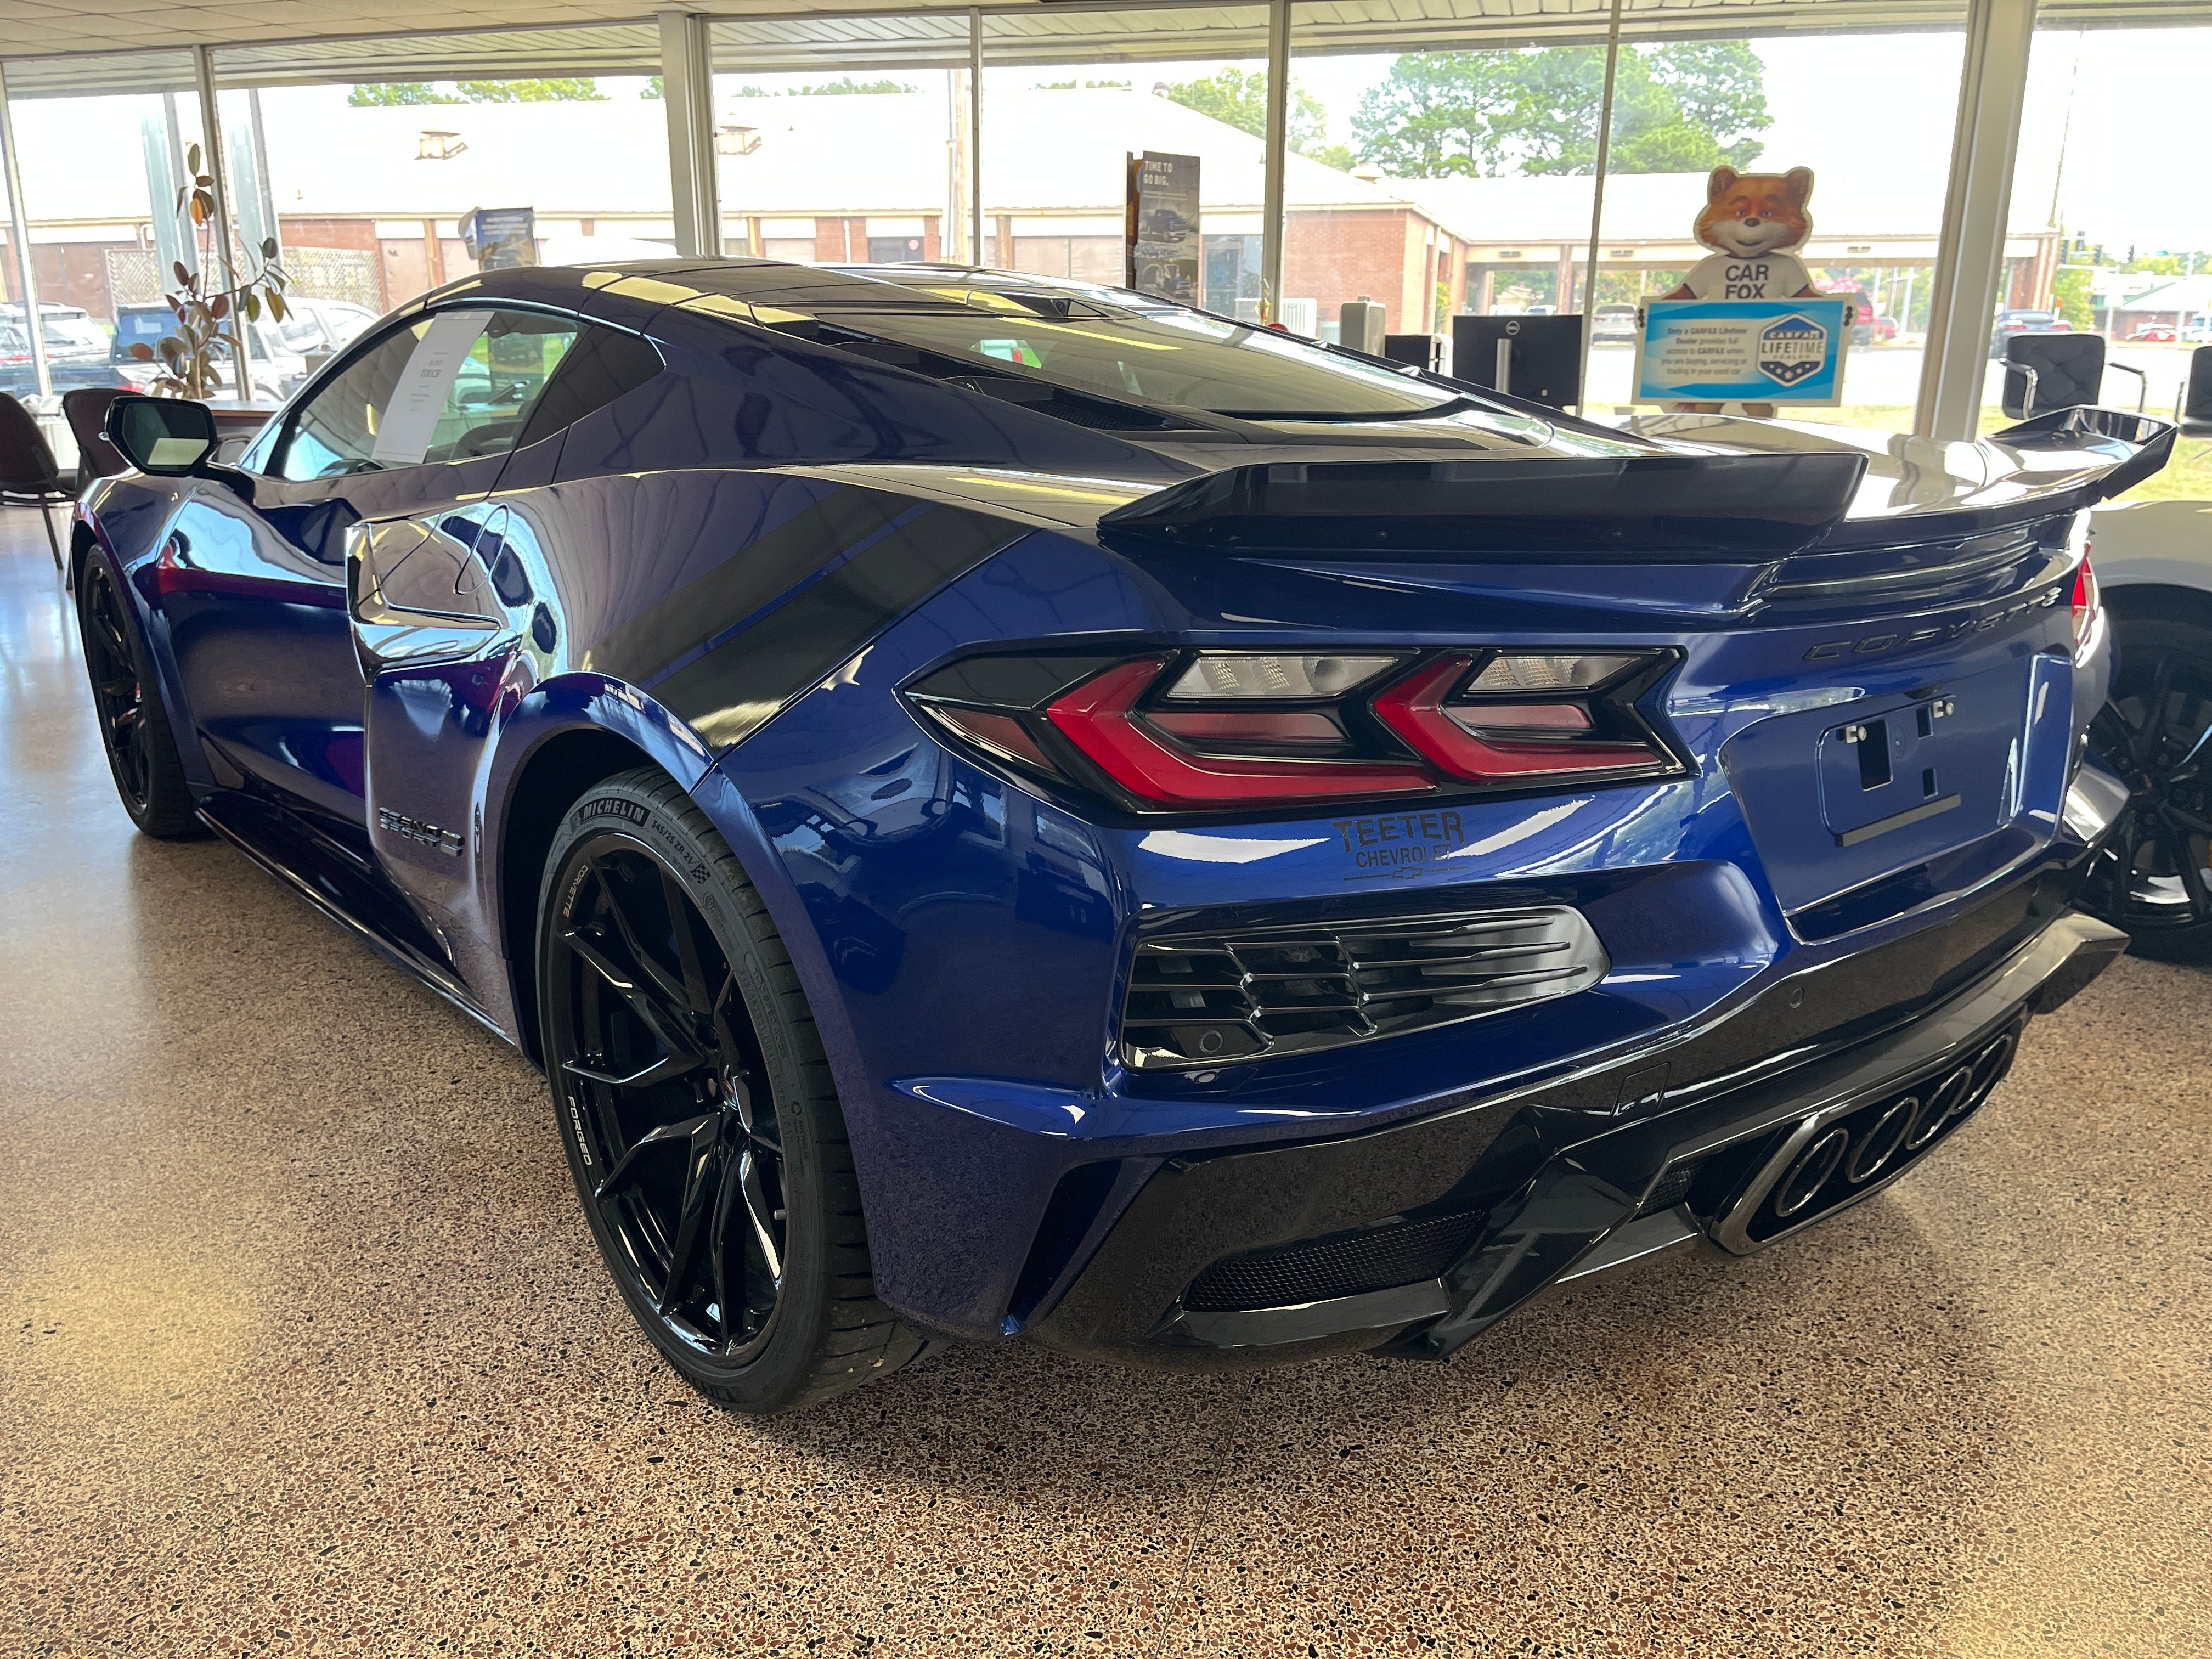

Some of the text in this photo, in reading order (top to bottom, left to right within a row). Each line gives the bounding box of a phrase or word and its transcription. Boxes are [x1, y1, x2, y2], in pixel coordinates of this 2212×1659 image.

[1144, 161, 1173, 173] TIME TO
[1143, 174, 1170, 185] GO BIG.
[1726, 264, 1768, 281] CAR
[1725, 283, 1765, 299] FOX
[1762, 342, 1824, 353] LIFETIME
[420, 369, 441, 378] TOUCH
[1802, 586, 2062, 661] CORVETTE
[583, 799, 645, 822] MICHELIN
[652, 820, 675, 844] 345/25
[674, 840, 685, 854] ZR
[1333, 810, 1465, 853] TEETER
[1356, 843, 1451, 868] CHEVROLET
[563, 865, 588, 918] CORVETTE
[568, 1096, 592, 1165] FORGED
